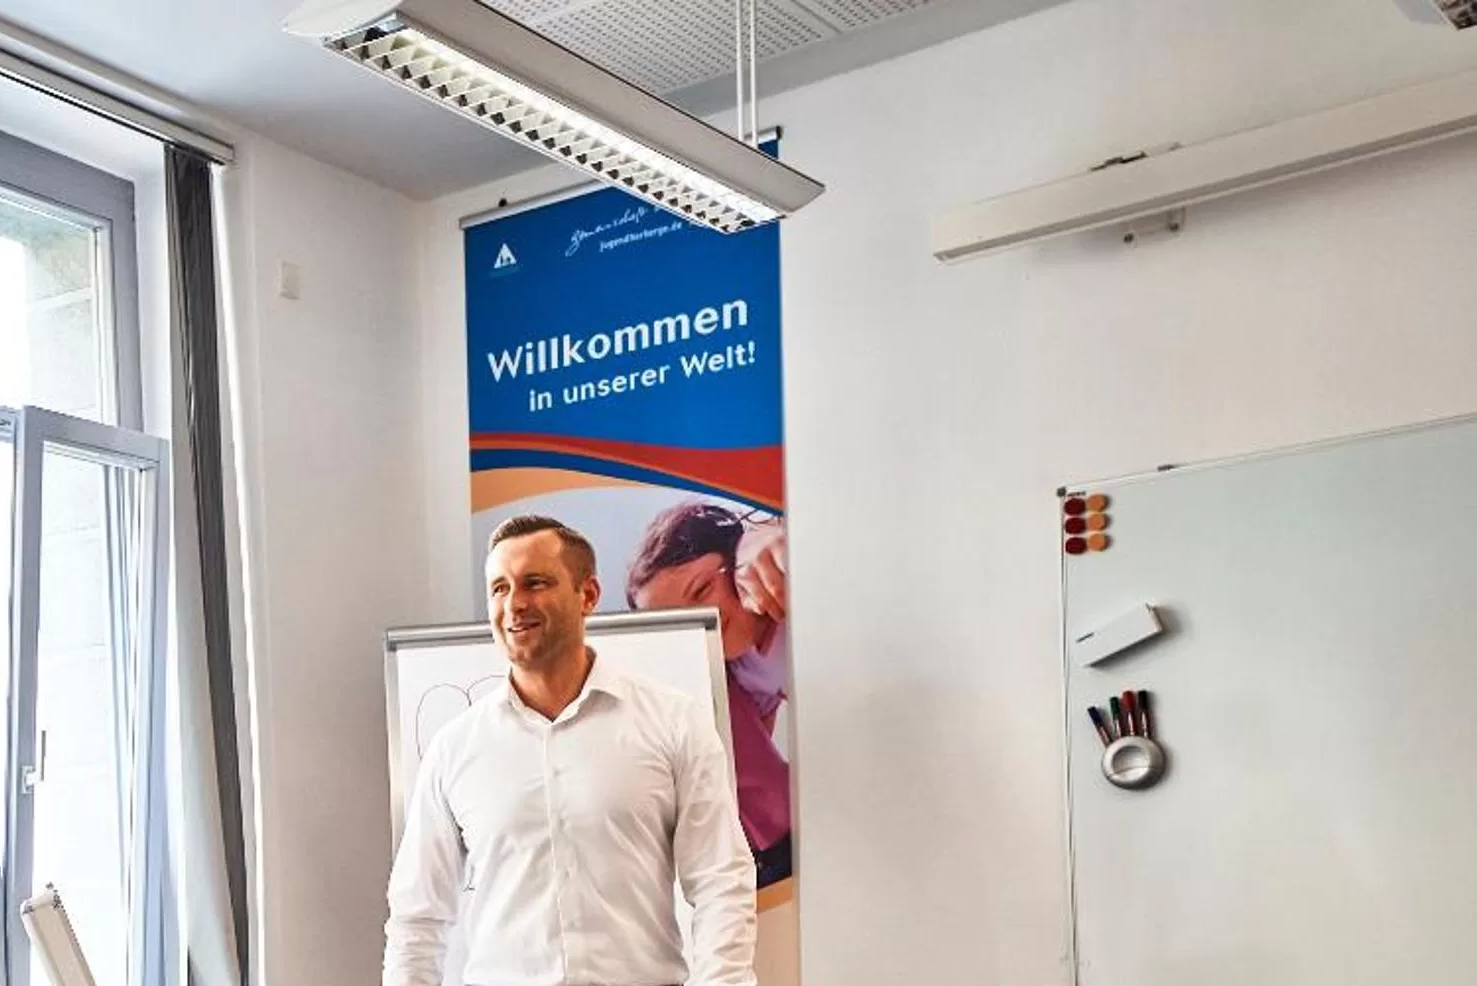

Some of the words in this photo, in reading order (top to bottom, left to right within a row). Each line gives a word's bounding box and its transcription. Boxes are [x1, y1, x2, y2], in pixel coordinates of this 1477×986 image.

[487, 299, 749, 382] Willkommen
[529, 388, 552, 412] in
[563, 364, 670, 404] unserer
[681, 341, 756, 378] Welt!
